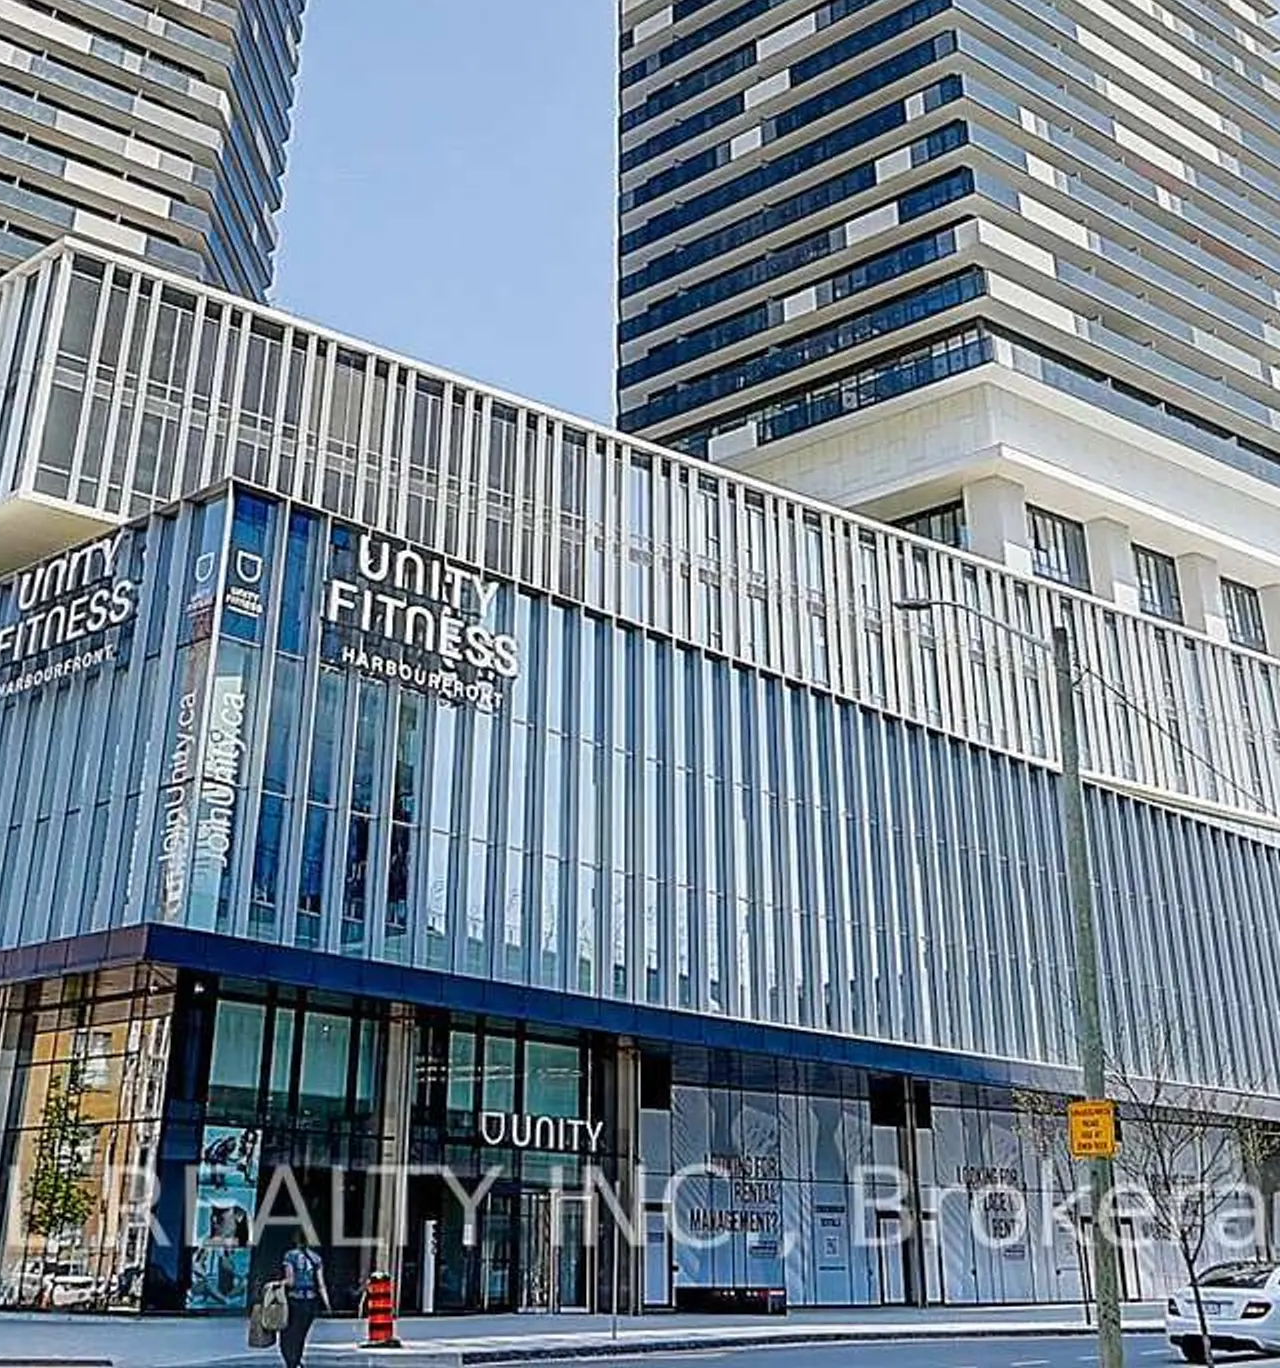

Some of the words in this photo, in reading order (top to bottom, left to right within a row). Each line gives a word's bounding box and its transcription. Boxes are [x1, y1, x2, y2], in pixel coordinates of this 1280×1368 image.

[18, 527, 126, 611] UNITY
[360, 534, 501, 618] UNITY
[328, 579, 518, 677] FITNESS
[512, 1113, 604, 1152] UNITY
[689, 1208, 779, 1234] MANAGEMENT?
